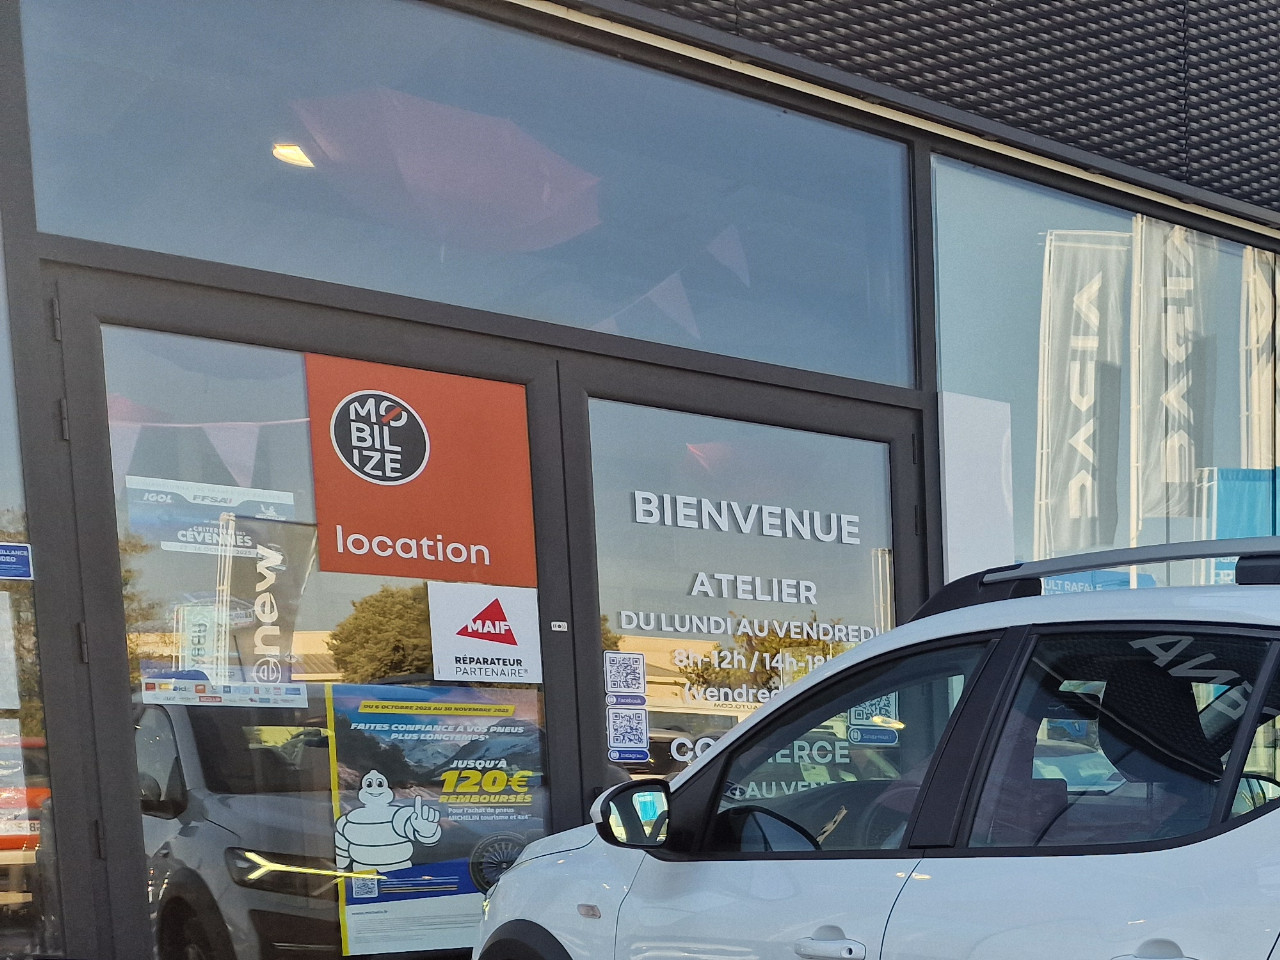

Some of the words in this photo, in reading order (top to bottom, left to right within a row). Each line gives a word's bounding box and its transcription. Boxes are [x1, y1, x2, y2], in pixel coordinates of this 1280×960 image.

[143, 492, 173, 504] IGOL
[633, 490, 860, 545] BIENVENUE
[336, 524, 490, 565] location
[690, 571, 818, 605] ATELIER
[467, 620, 510, 634] MAIF
[620, 610, 656, 631] DU
[660, 612, 732, 635] LUNDI
[737, 618, 769, 638] AU
[771, 620, 879, 644] VENDREDI
[454, 653, 523, 667] RÉPARATEUR
[673, 649, 747, 670] 8h-12h
[350, 722, 390, 731] FAITES
[391, 724, 455, 732] CONFIANCE
[450, 758, 507, 770] JUSQU'À
[440, 769, 533, 793] 120€
[745, 781, 777, 798] AU
[438, 793, 532, 803] REMBOURSÉS
